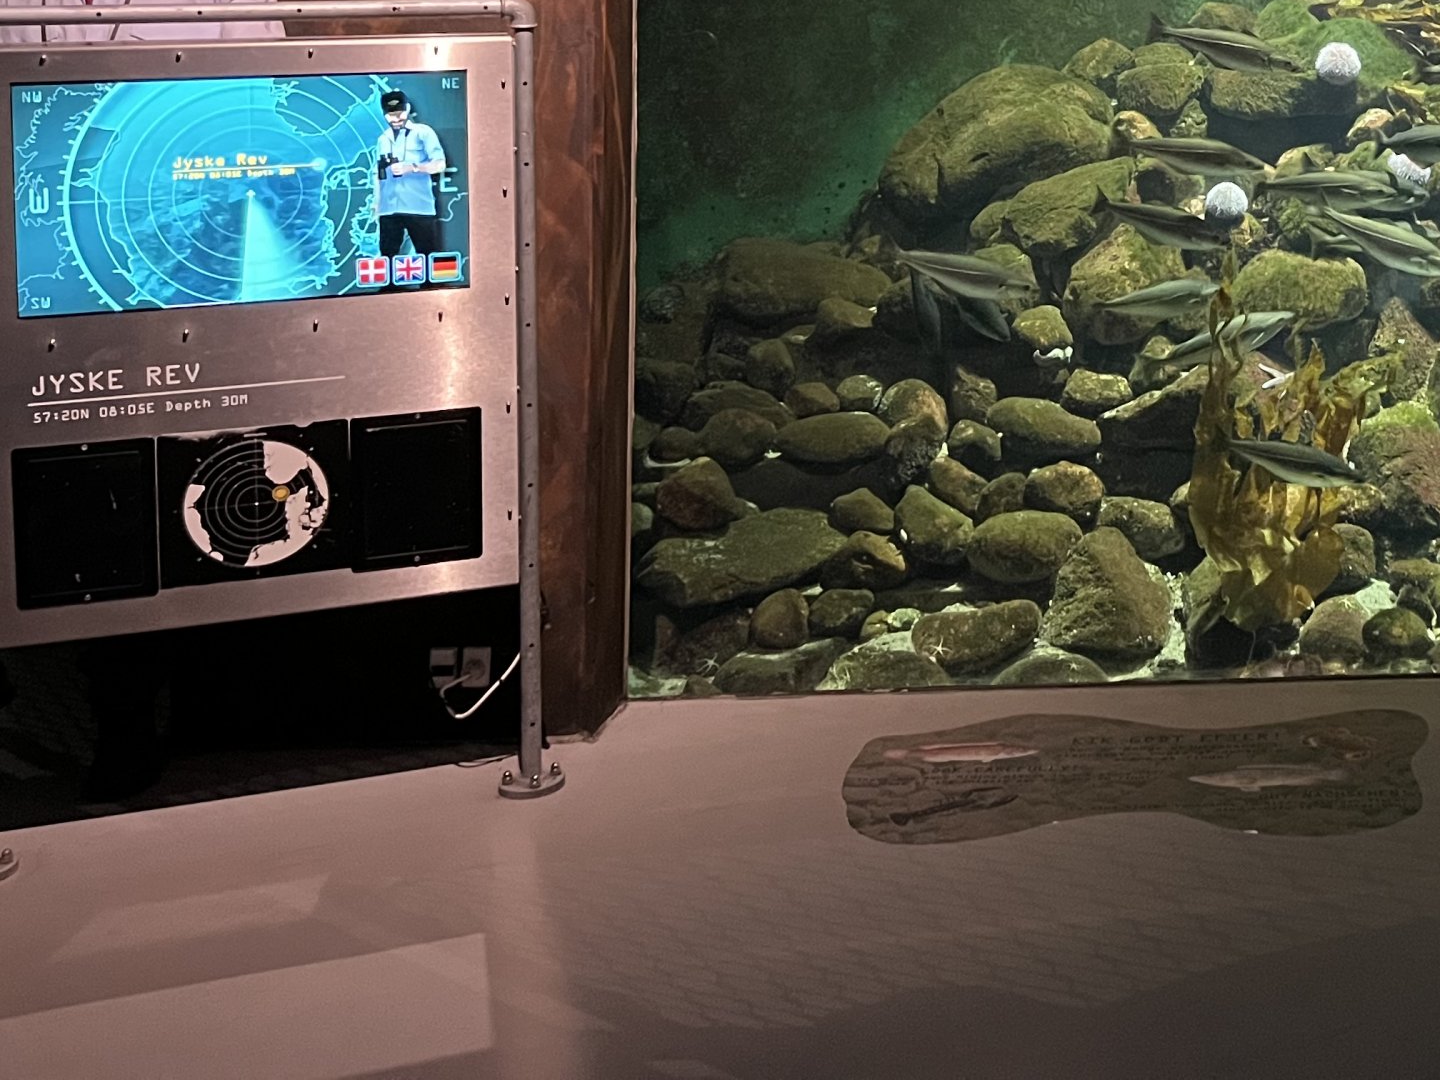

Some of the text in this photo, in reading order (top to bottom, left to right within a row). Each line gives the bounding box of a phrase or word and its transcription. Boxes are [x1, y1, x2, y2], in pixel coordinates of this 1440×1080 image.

[442, 77, 460, 90] NE
[173, 152, 268, 171] Jyske Rev
[31, 362, 201, 397] JYSKE REV
[166, 399, 212, 413] Depth
[221, 393, 250, 408] 30M
